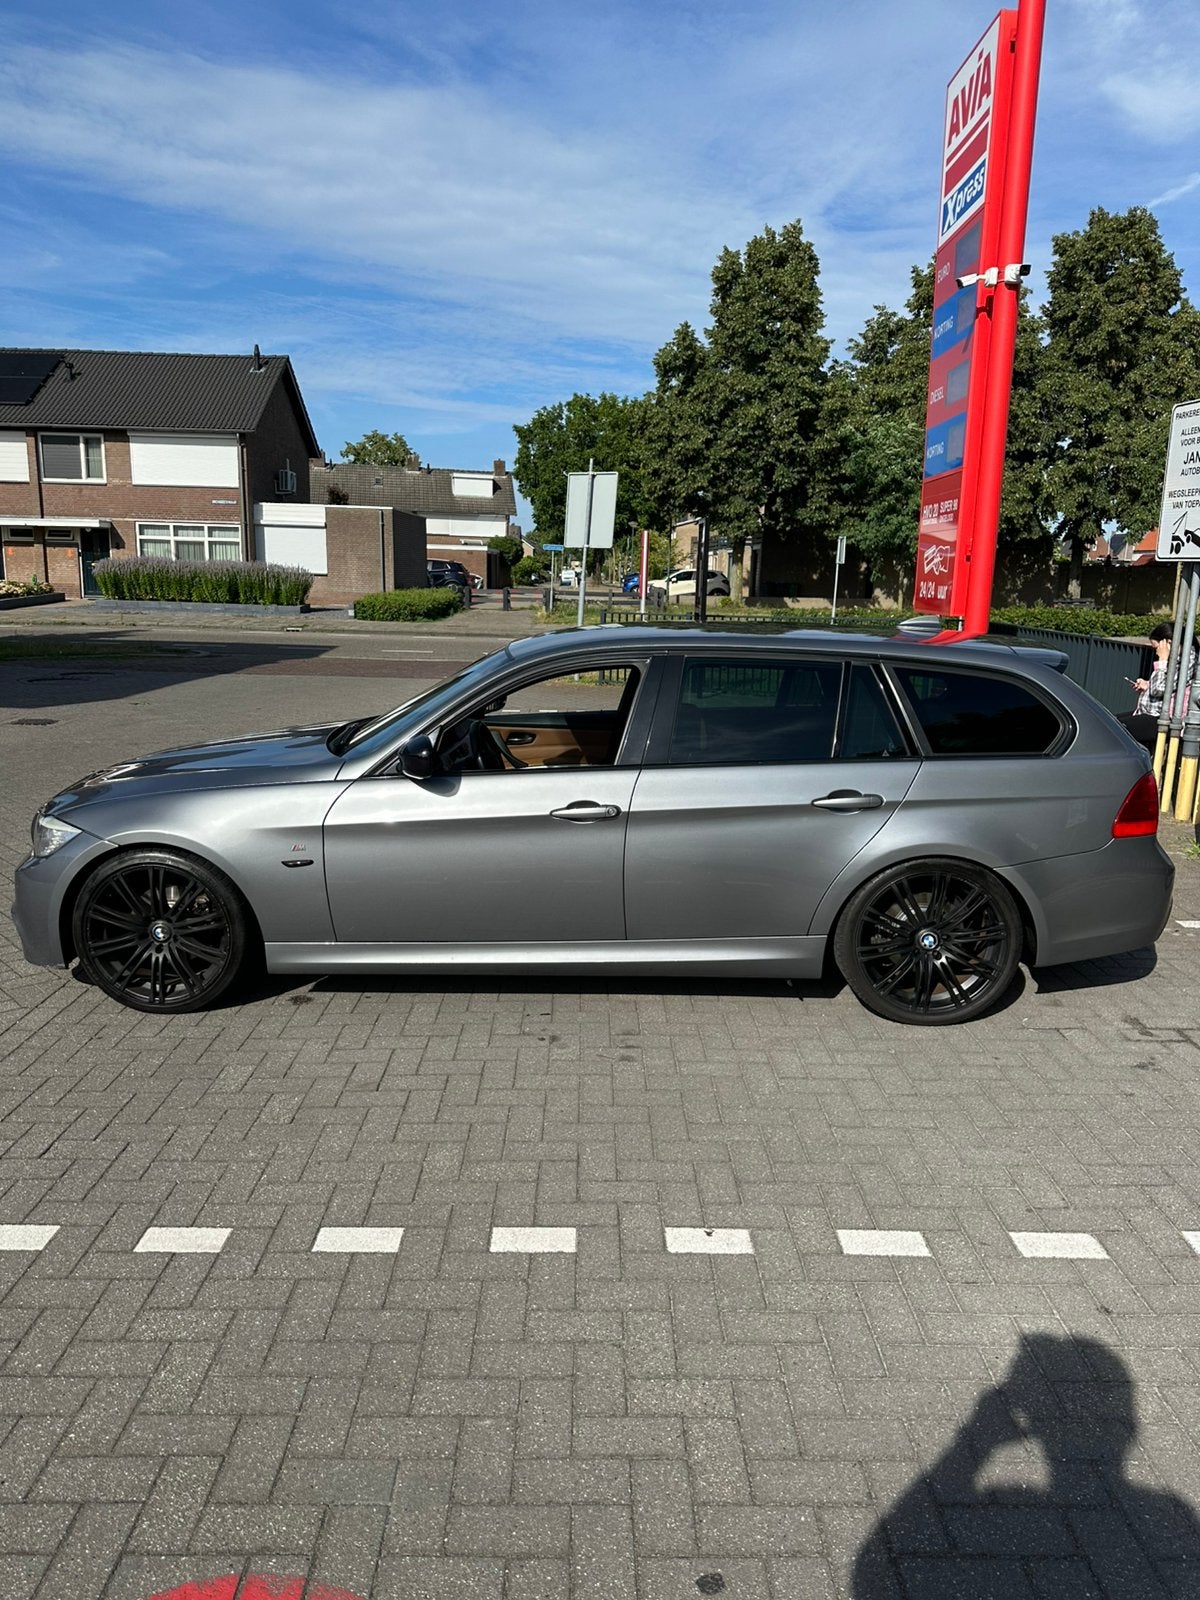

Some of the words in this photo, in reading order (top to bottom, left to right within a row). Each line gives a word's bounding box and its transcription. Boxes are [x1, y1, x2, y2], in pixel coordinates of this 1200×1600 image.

[943, 166, 985, 234] Xpress
[929, 386, 944, 405] DIESEL
[1180, 438, 1196, 447] VOOR
[1172, 501, 1184, 509] VAN
